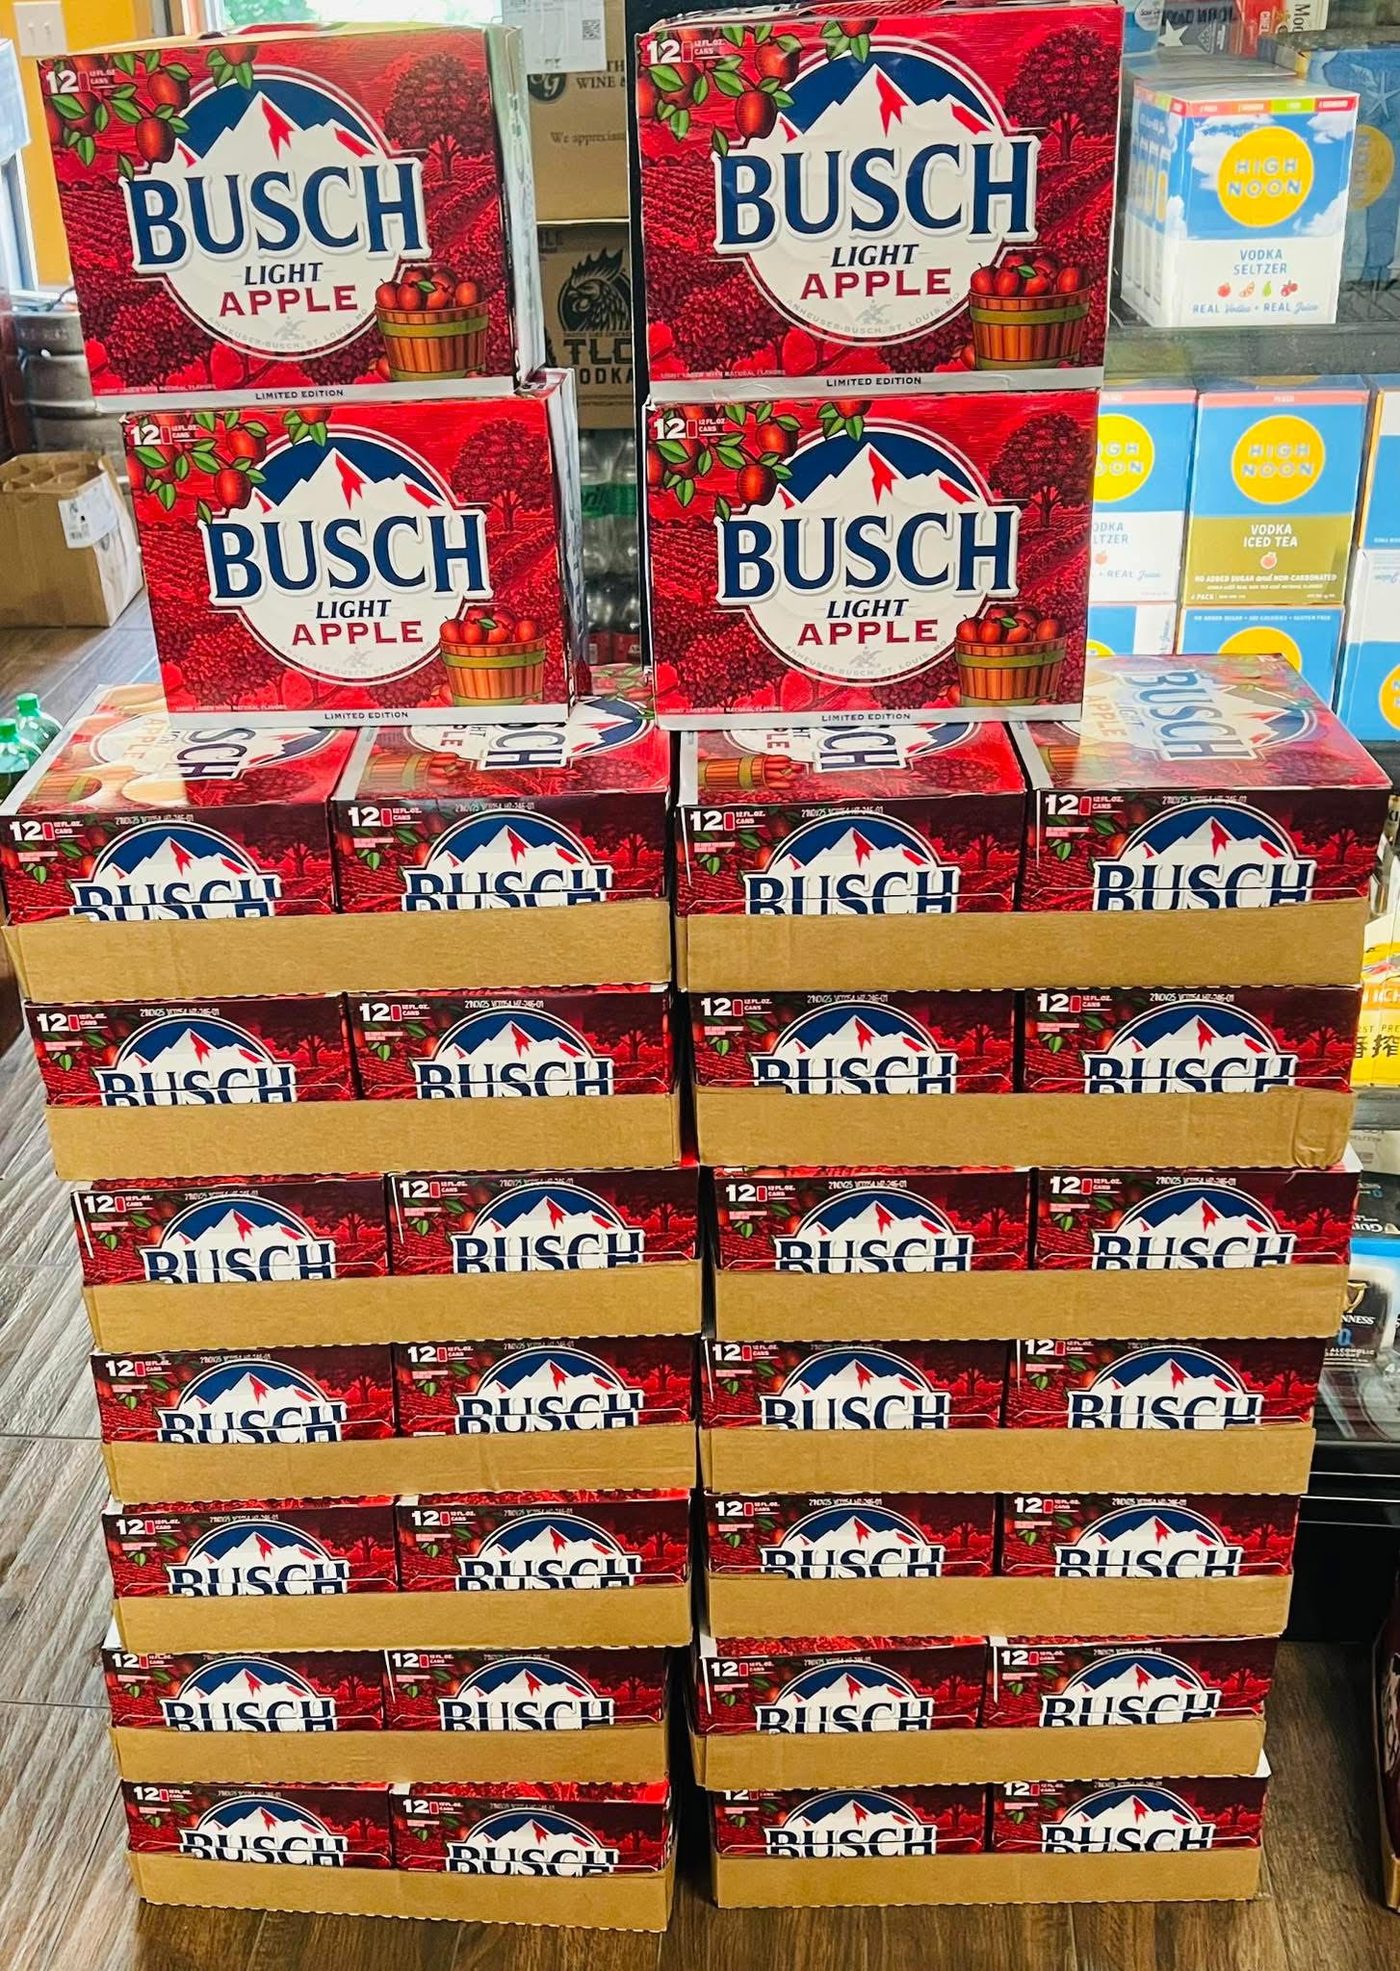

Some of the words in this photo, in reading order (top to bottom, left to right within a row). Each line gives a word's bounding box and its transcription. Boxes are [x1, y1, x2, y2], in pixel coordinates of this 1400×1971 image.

[647, 39, 682, 64] 12
[46, 70, 79, 93] 12
[577, 77, 616, 89] WINE
[1236, 158, 1298, 174] HIGH
[719, 141, 1033, 247] BUSCH
[1229, 180, 1301, 197] NOON
[129, 162, 424, 266] BUSCH
[831, 244, 919, 267] LIGHT
[1239, 249, 1283, 261] VODKA
[244, 262, 323, 285] LIGHT
[1233, 263, 1288, 275] SELTZER
[801, 268, 951, 300] APPLE
[219, 285, 358, 317] APPLE
[1192, 304, 1220, 314] REAL
[1263, 303, 1291, 312] REAL
[826, 377, 874, 386] LIMITED
[878, 376, 922, 385] EDITION
[255, 391, 298, 400] LIMITED
[301, 389, 344, 398] EDITION
[130, 425, 160, 445] 12
[654, 418, 686, 440] 12
[1249, 444, 1310, 457] HIGH
[1241, 463, 1315, 477] NOON
[1251, 524, 1292, 535] VODKA
[1243, 537, 1271, 547] ICED
[1275, 537, 1298, 547] TEA
[207, 516, 486, 599] BUSCH
[722, 511, 1017, 599] BUSCH
[1107, 570, 1134, 578] REAL
[316, 600, 391, 619] LIGHT
[826, 599, 909, 619] LIGHT
[292, 621, 423, 646] APPLE
[797, 620, 938, 646] APPLE
[324, 712, 366, 721] LIMITED
[370, 711, 409, 720] EDITION
[821, 713, 864, 721] LIMITED
[868, 712, 910, 721] EDITION
[1128, 670, 1252, 759] BUSCH
[1046, 794, 1080, 815] 12
[348, 807, 381, 827] 12
[690, 811, 724, 831] 12
[10, 821, 43, 841] 12
[701, 998, 732, 1016] 12
[1037, 993, 1070, 1012] 12
[359, 1003, 391, 1022] 12
[37, 1013, 68, 1032] 12
[400, 1180, 430, 1198] 12
[726, 1184, 756, 1202] 12
[1050, 1176, 1081, 1194] 12
[83, 1195, 115, 1213] 12
[408, 1346, 437, 1362] 12
[712, 1344, 742, 1360] 12
[1025, 1340, 1055, 1355] 12
[106, 1360, 135, 1377] 12
[715, 1501, 744, 1516] 12
[1014, 1497, 1043, 1513] 12
[412, 1510, 442, 1526] 12
[116, 1519, 146, 1535] 12
[112, 1653, 139, 1668] 12
[392, 1653, 419, 1668] 12
[1001, 1650, 1029, 1665] 12
[711, 1662, 738, 1676] 12
[134, 1787, 160, 1801] 12
[1004, 1782, 1030, 1796] 12
[403, 1799, 429, 1813] 12
